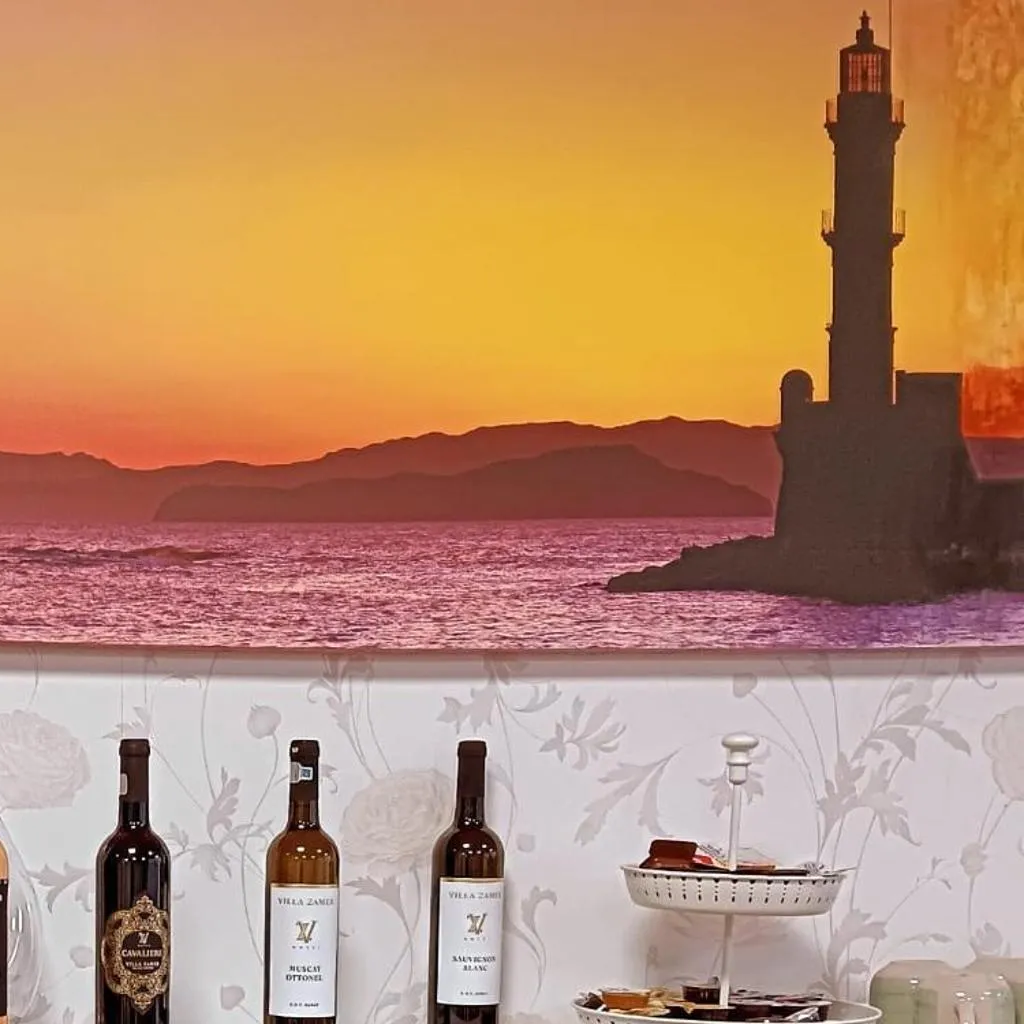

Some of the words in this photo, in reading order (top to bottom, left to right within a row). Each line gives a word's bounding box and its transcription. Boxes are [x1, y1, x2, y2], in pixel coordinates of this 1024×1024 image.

[449, 891, 475, 899] VILLA
[277, 897, 304, 906] VILLA
[452, 955, 496, 963] SAUVIGNON
[288, 965, 321, 973] MUSCAT
[285, 974, 323, 982] OTTONEL
